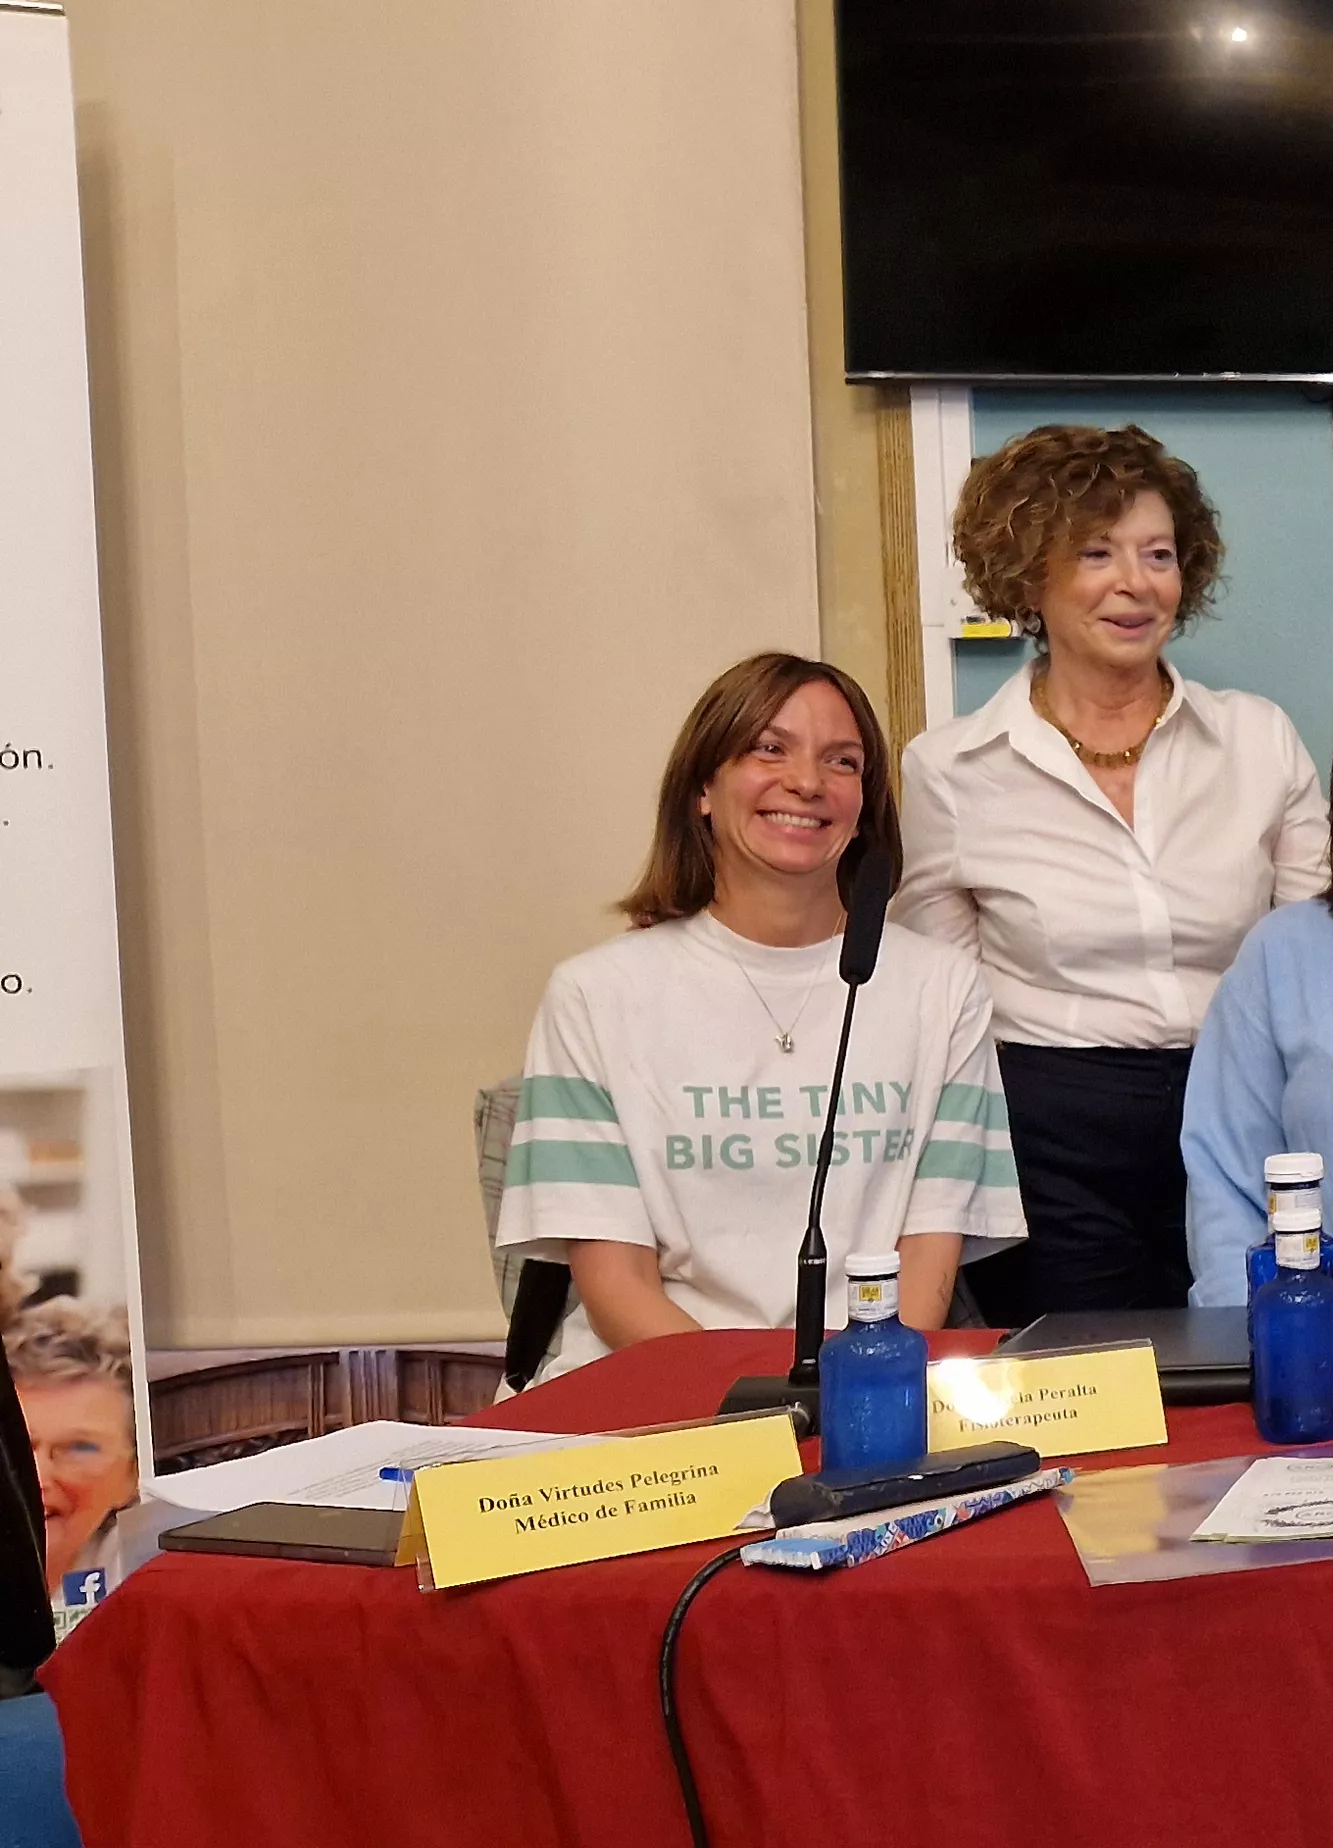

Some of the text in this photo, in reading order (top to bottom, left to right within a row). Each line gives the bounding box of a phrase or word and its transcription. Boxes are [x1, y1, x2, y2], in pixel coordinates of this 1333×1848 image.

[682, 1081, 913, 1120] THE TINY
[665, 1129, 915, 1170] BIG SISTER
[1038, 1384, 1097, 1402] Peralta
[478, 1463, 719, 1514] Doña Virtudes Pelegrina
[514, 1491, 697, 1535] Médico de Familia
